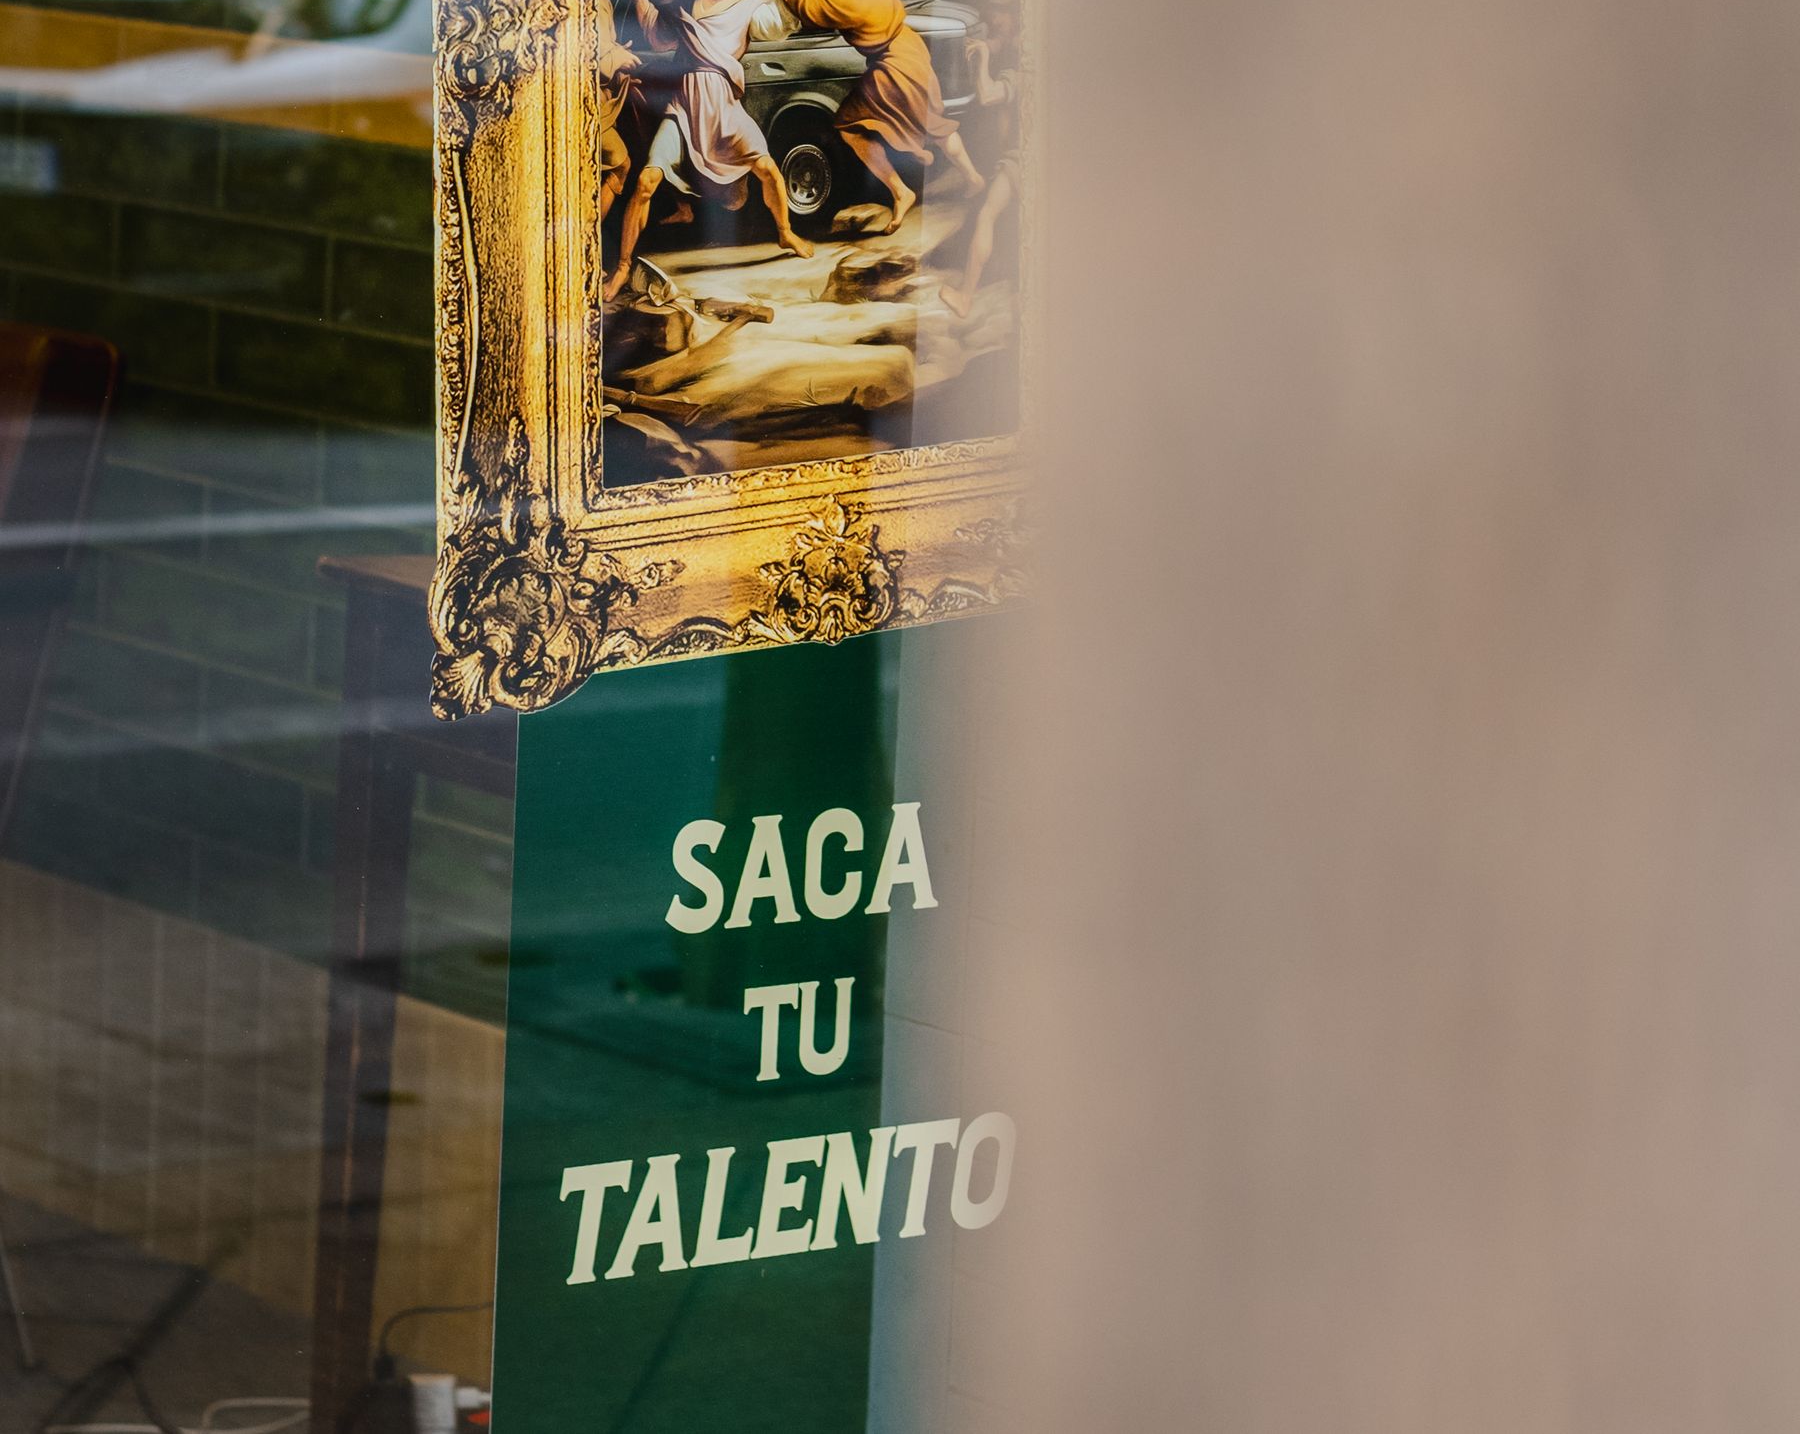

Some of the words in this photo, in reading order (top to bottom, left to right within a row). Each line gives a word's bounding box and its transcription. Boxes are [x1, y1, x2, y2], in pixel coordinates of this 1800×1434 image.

[664, 801, 939, 934] SACA
[743, 976, 856, 1082] TU
[559, 1111, 1017, 1285] TALENTO
